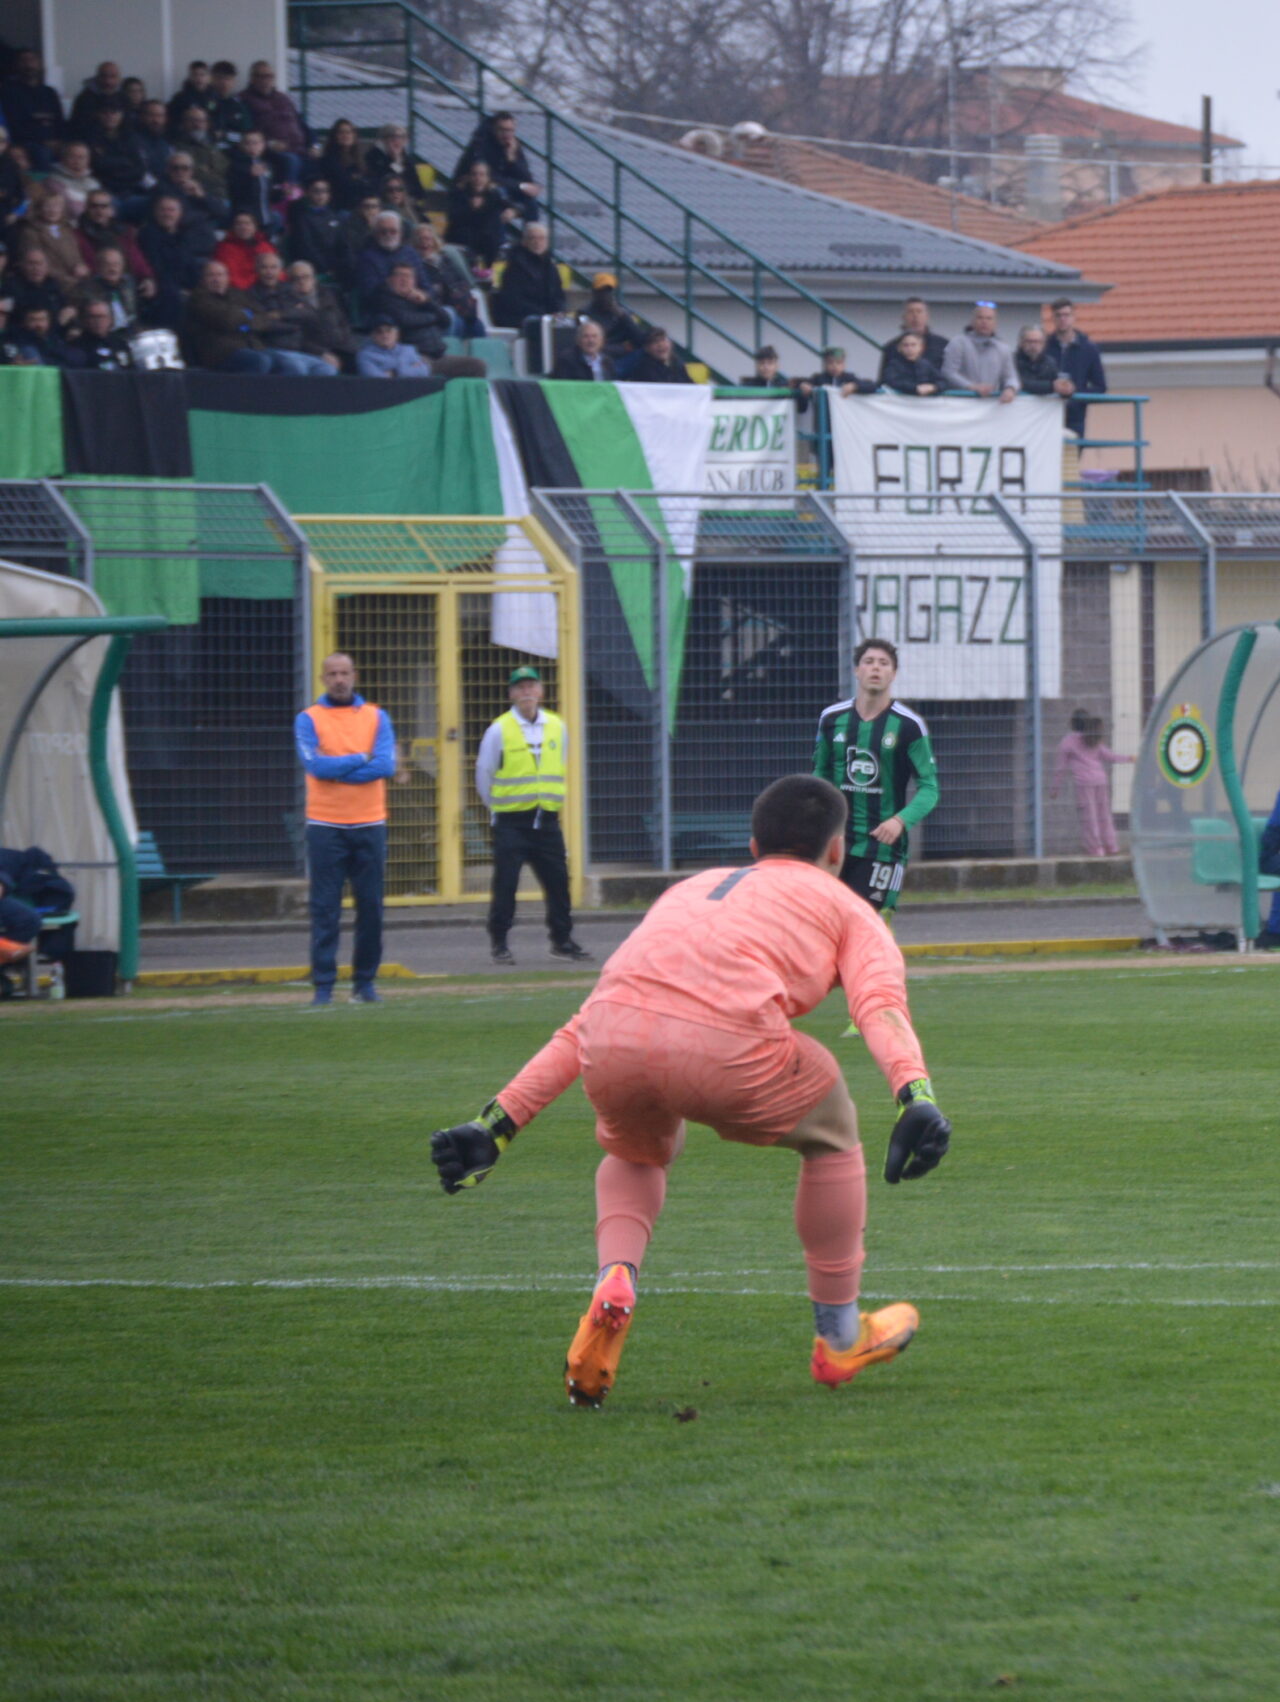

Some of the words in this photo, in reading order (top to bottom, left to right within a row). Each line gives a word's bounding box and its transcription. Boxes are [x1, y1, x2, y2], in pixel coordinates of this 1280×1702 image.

[707, 413, 788, 453] ERDE
[736, 467, 785, 493] CLUB
[872, 443, 1027, 516] FORZA
[854, 573, 1029, 645] RAGAZZ
[868, 861, 893, 891] 19
